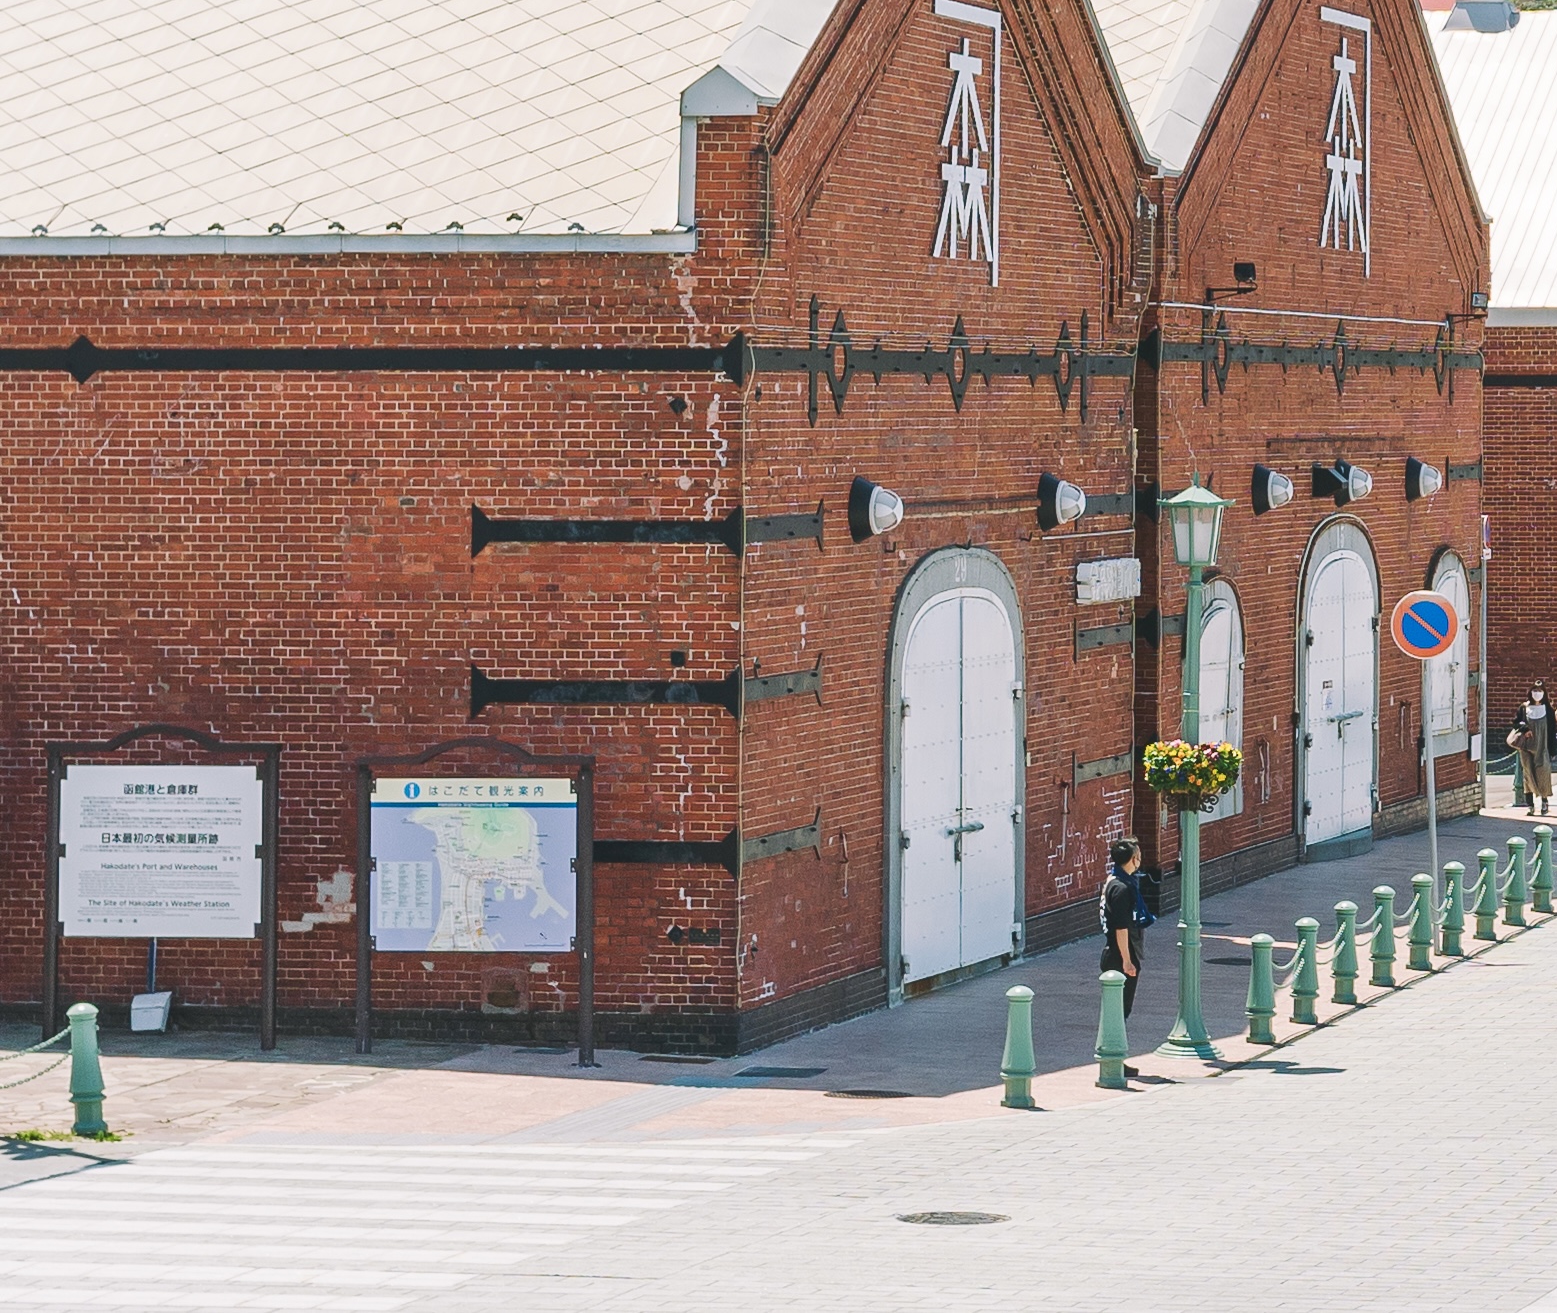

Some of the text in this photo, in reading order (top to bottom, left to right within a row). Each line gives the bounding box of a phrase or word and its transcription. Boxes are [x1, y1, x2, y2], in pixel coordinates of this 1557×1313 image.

[123, 784, 199, 795] 函館港と倉庫群
[428, 785, 545, 797] はこだて観光案内
[101, 833, 219, 844] 日本最初の気候測量所跡
[101, 863, 218, 871] Hakodate's Port and Warehouses
[88, 899, 230, 908] The Site of Hakodate's Weather Station
